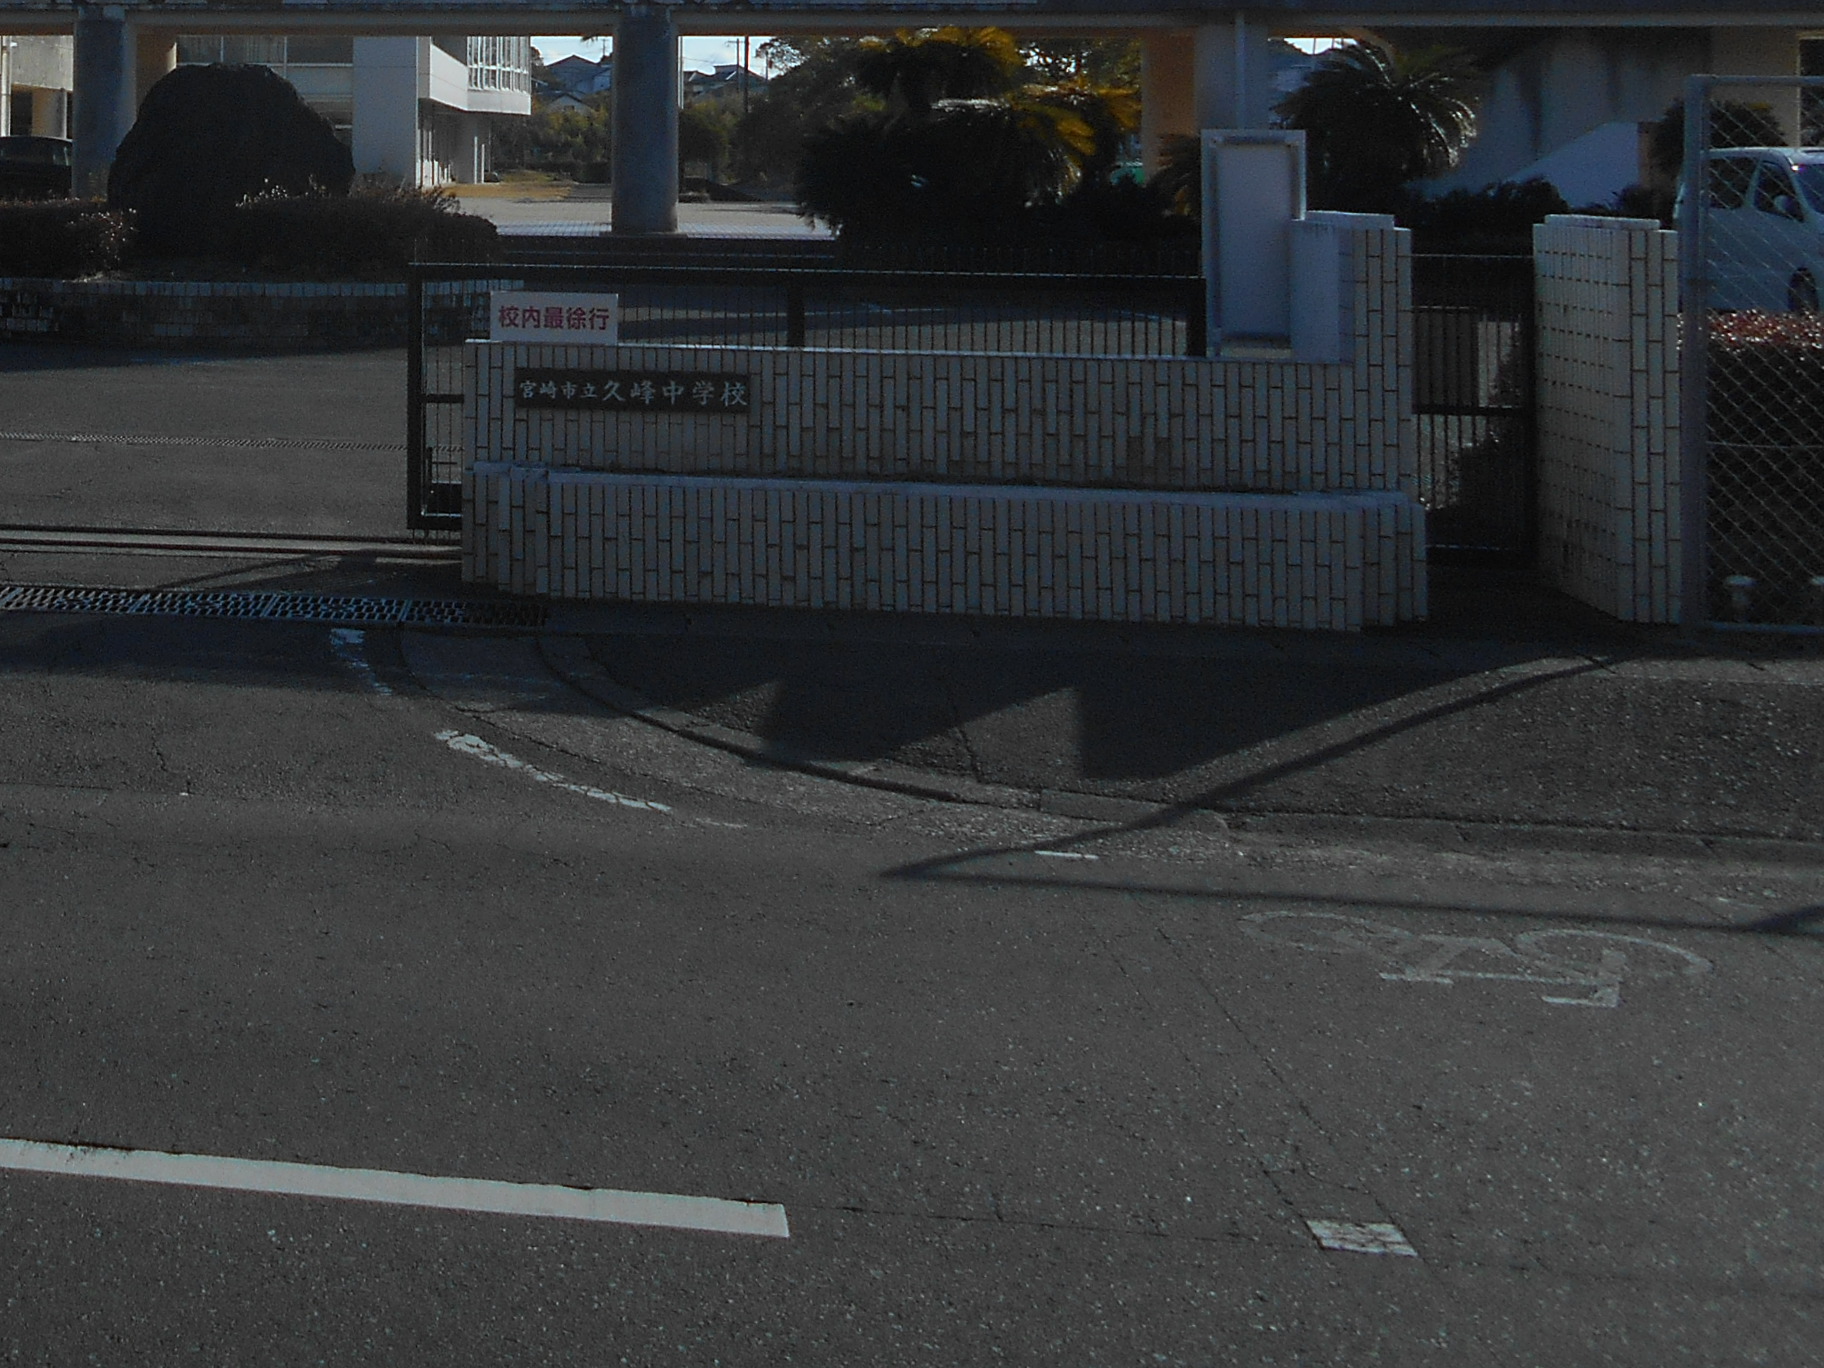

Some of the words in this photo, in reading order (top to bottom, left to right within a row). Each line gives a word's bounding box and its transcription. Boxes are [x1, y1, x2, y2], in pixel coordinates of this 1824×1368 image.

[498, 305, 610, 331] 校内最徐行
[519, 380, 748, 407] 宮崎市立久峰中学校
